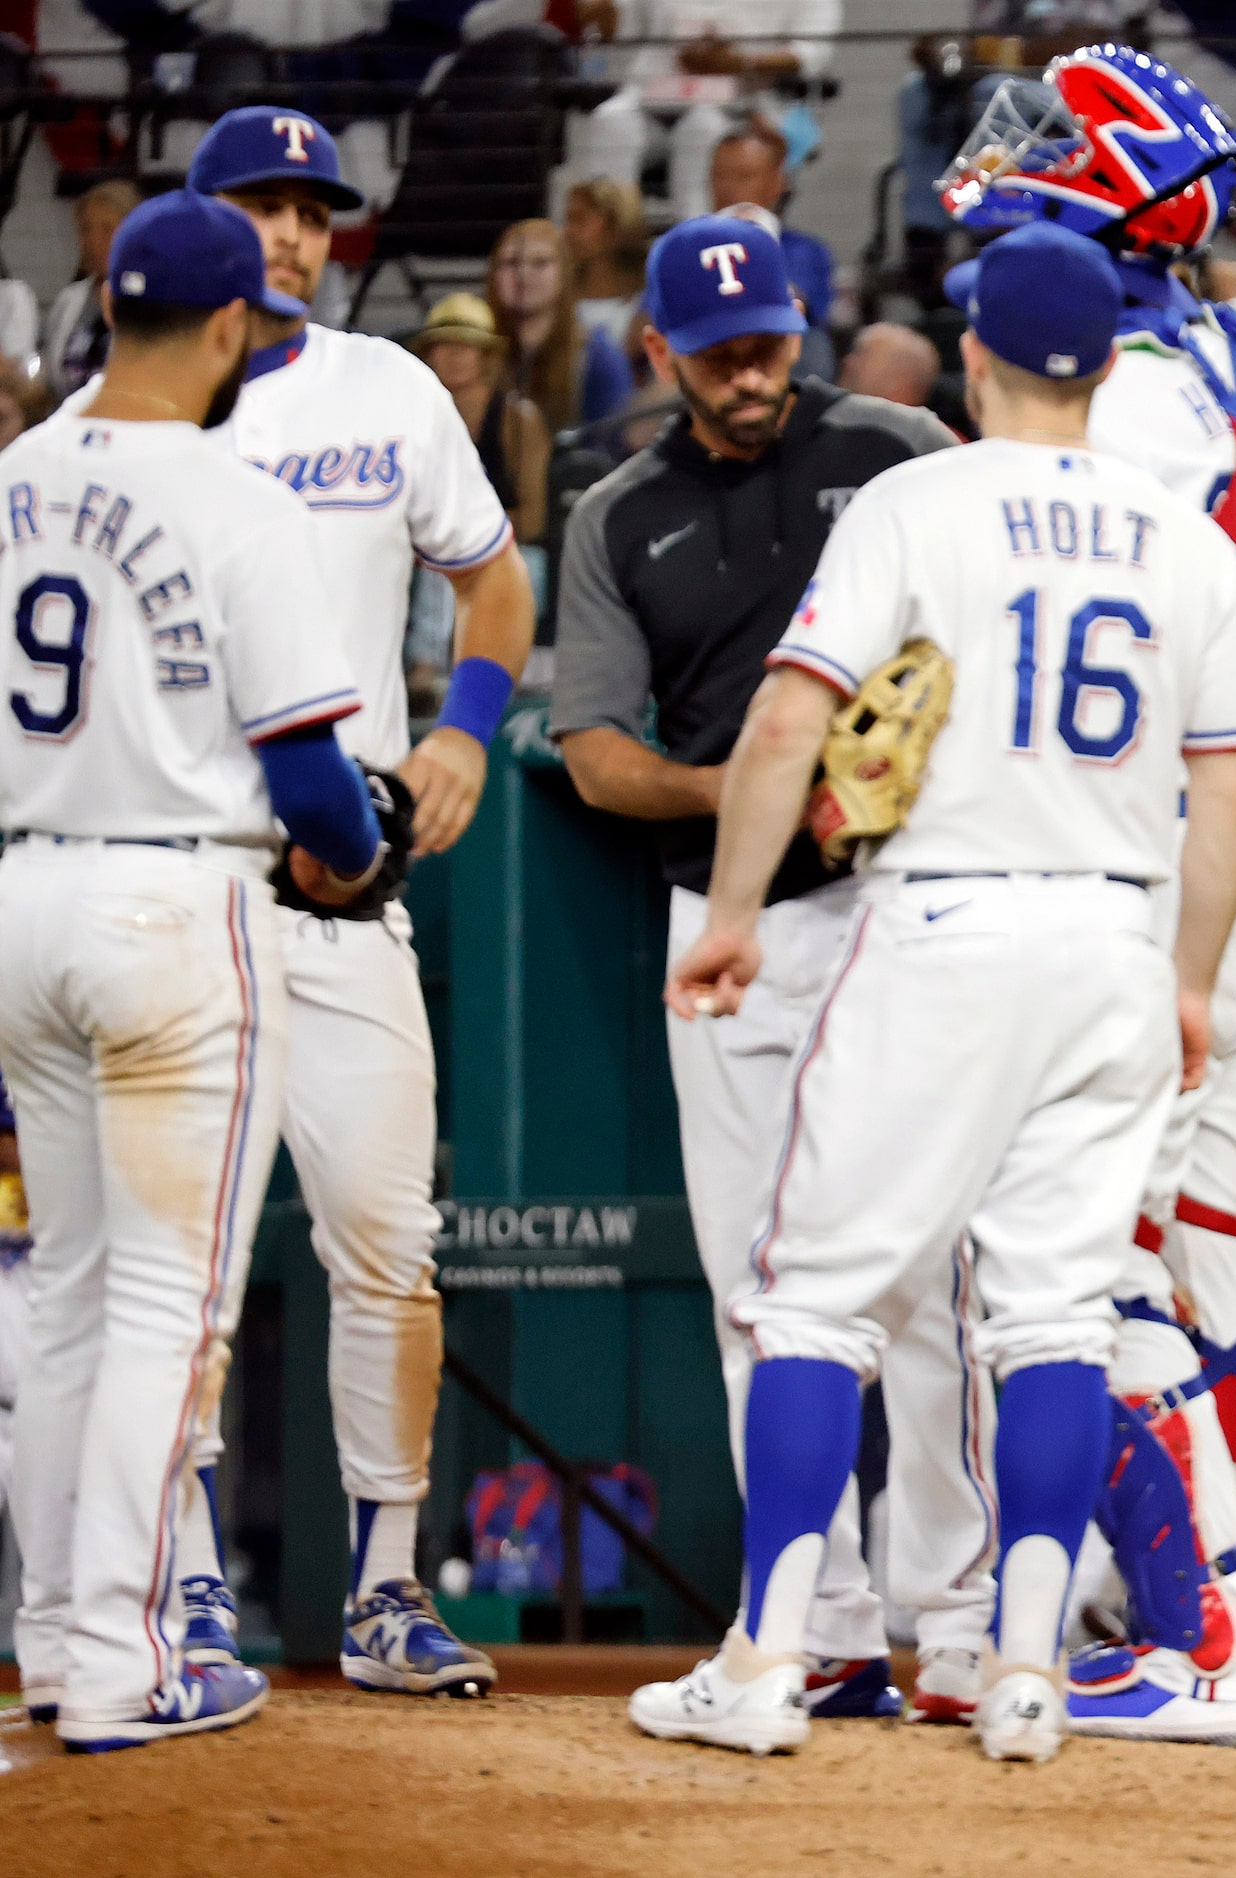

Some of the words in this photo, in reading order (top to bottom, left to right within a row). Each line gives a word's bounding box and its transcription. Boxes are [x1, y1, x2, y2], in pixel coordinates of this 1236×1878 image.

[272, 116, 317, 163] T
[700, 242, 749, 296] T
[1000, 497, 1158, 569] HOLT
[2, 482, 211, 693] R-FALEFA
[1005, 587, 1161, 768] 16
[434, 1200, 638, 1250] CHOCTAW
